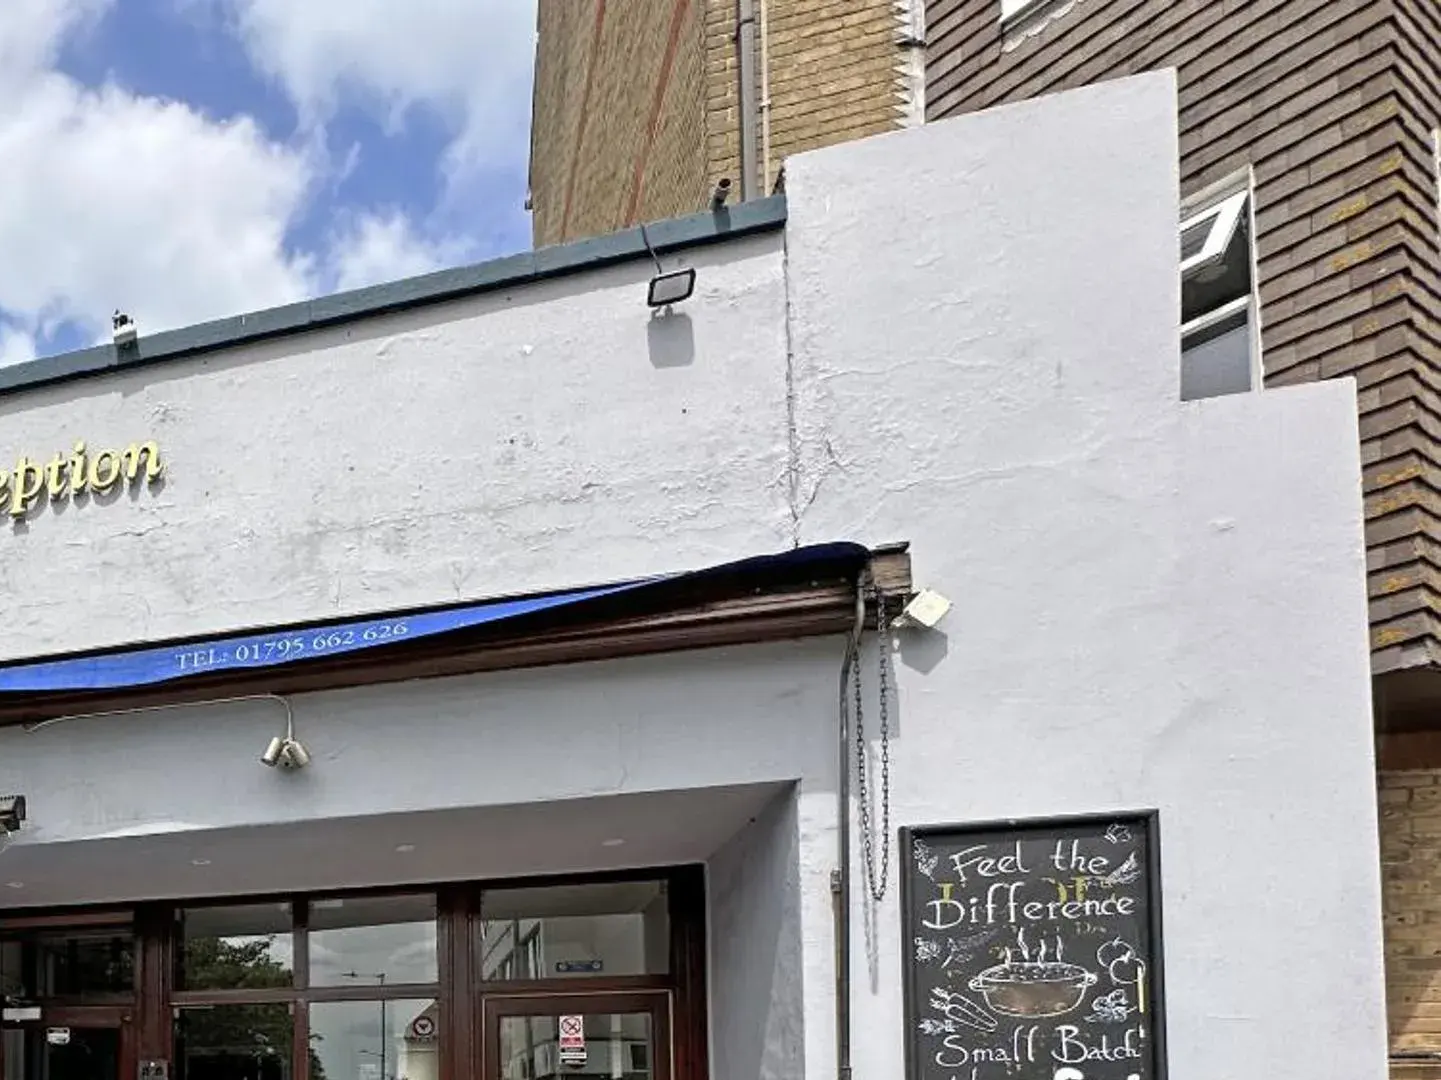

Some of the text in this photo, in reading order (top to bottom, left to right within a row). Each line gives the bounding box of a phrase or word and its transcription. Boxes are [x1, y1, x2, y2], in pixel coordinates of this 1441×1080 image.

[235, 639, 305, 661] 01795
[312, 631, 355, 650] 662
[362, 621, 409, 640] 626
[948, 839, 1109, 886] Feel the
[922, 881, 1135, 929] Difference
[935, 1025, 1141, 1067] Small Batch
